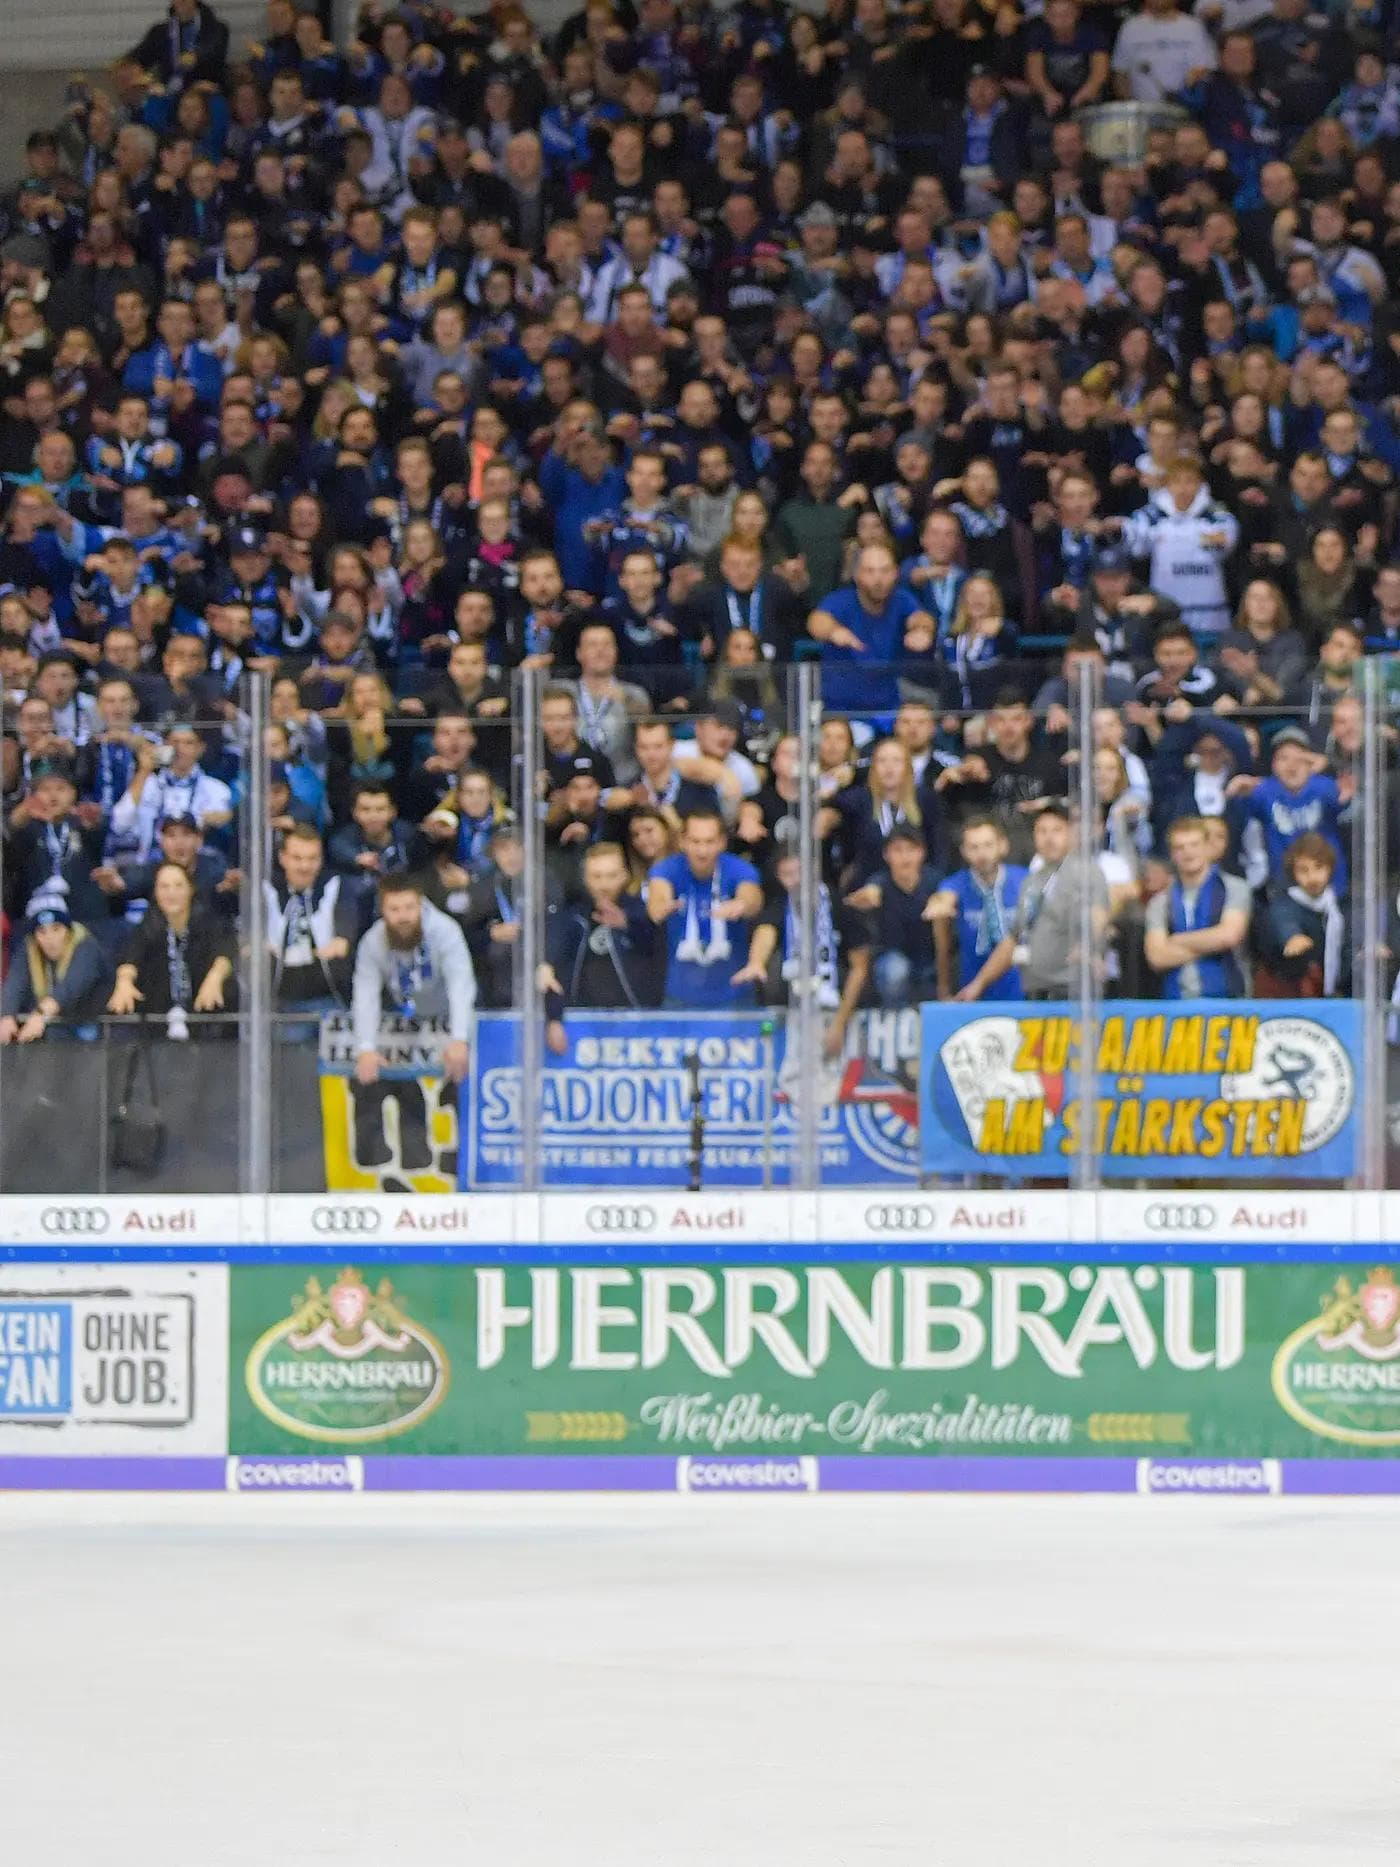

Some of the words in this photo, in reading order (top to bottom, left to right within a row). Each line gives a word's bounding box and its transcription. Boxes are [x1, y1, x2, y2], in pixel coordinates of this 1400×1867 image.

[979, 1097, 1046, 1154] AM
[123, 1208, 197, 1232] Audi
[394, 1207, 470, 1231] Audi
[669, 1207, 745, 1231] Audi
[950, 1206, 1028, 1230] Audi
[1230, 1206, 1308, 1229] Audi
[84, 1313, 169, 1352] OHNE
[475, 1265, 1247, 1379] HERRNBRÄU
[83, 1357, 177, 1405] JOB.
[640, 1388, 1074, 1452] Weißbier-Spezialitäten
[238, 1460, 348, 1487] covestro
[688, 1460, 803, 1487] covestro
[1150, 1463, 1265, 1489] covestro
